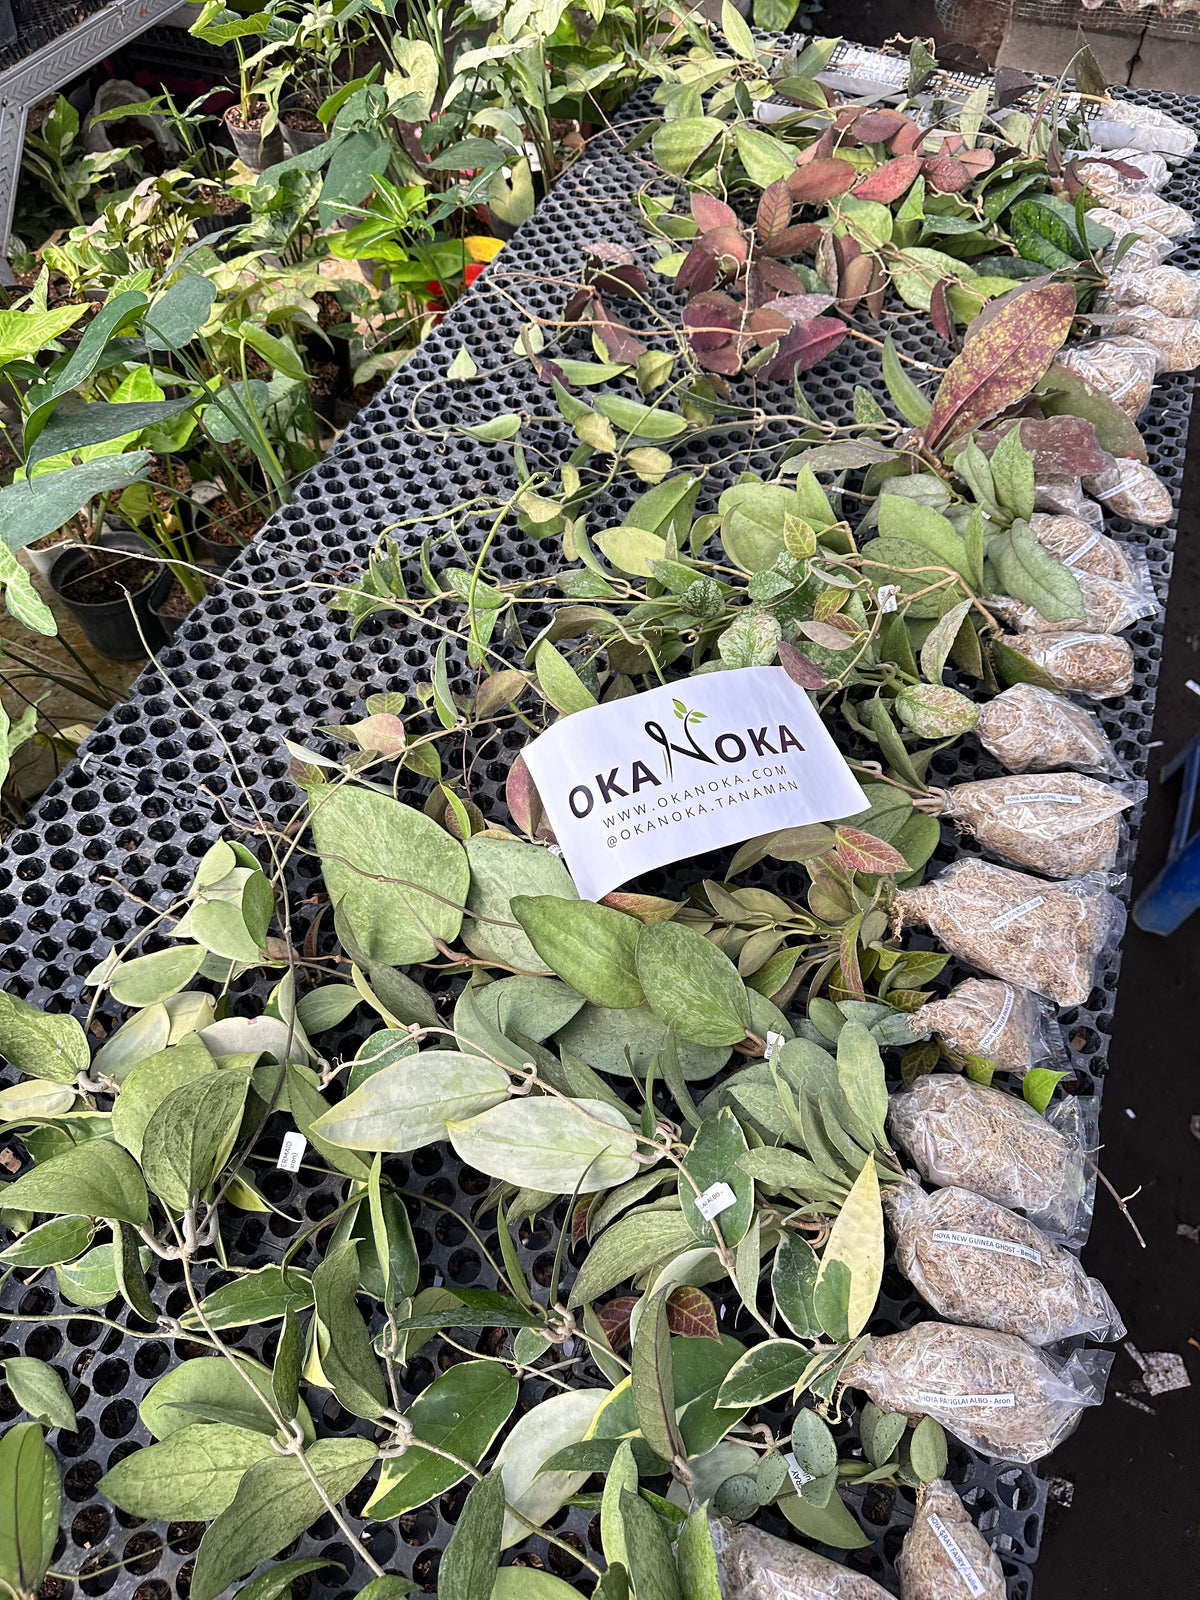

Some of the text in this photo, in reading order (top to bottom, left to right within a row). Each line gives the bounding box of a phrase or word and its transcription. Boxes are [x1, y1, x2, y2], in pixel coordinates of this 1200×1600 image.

[603, 765, 787, 829] WWW.OKANOKA.COM
[606, 780, 799, 849] @OKANOKA.TANAMAN
[992, 917, 1008, 927] HOYA
[982, 1034, 993, 1047] HOYA
[992, 1015, 1005, 1035] WINTER
[280, 1140, 293, 1168] ERMAID
[951, 1234, 967, 1242] NEW
[968, 1237, 994, 1248] GUINEA
[995, 1242, 1016, 1254] GHOST
[940, 1397, 968, 1405] PANGLAI
[929, 1515, 942, 1531] HOYA
[939, 1530, 954, 1548] GRAY
[950, 1547, 966, 1567] FAIRY
[965, 1573, 978, 1591] Julie
